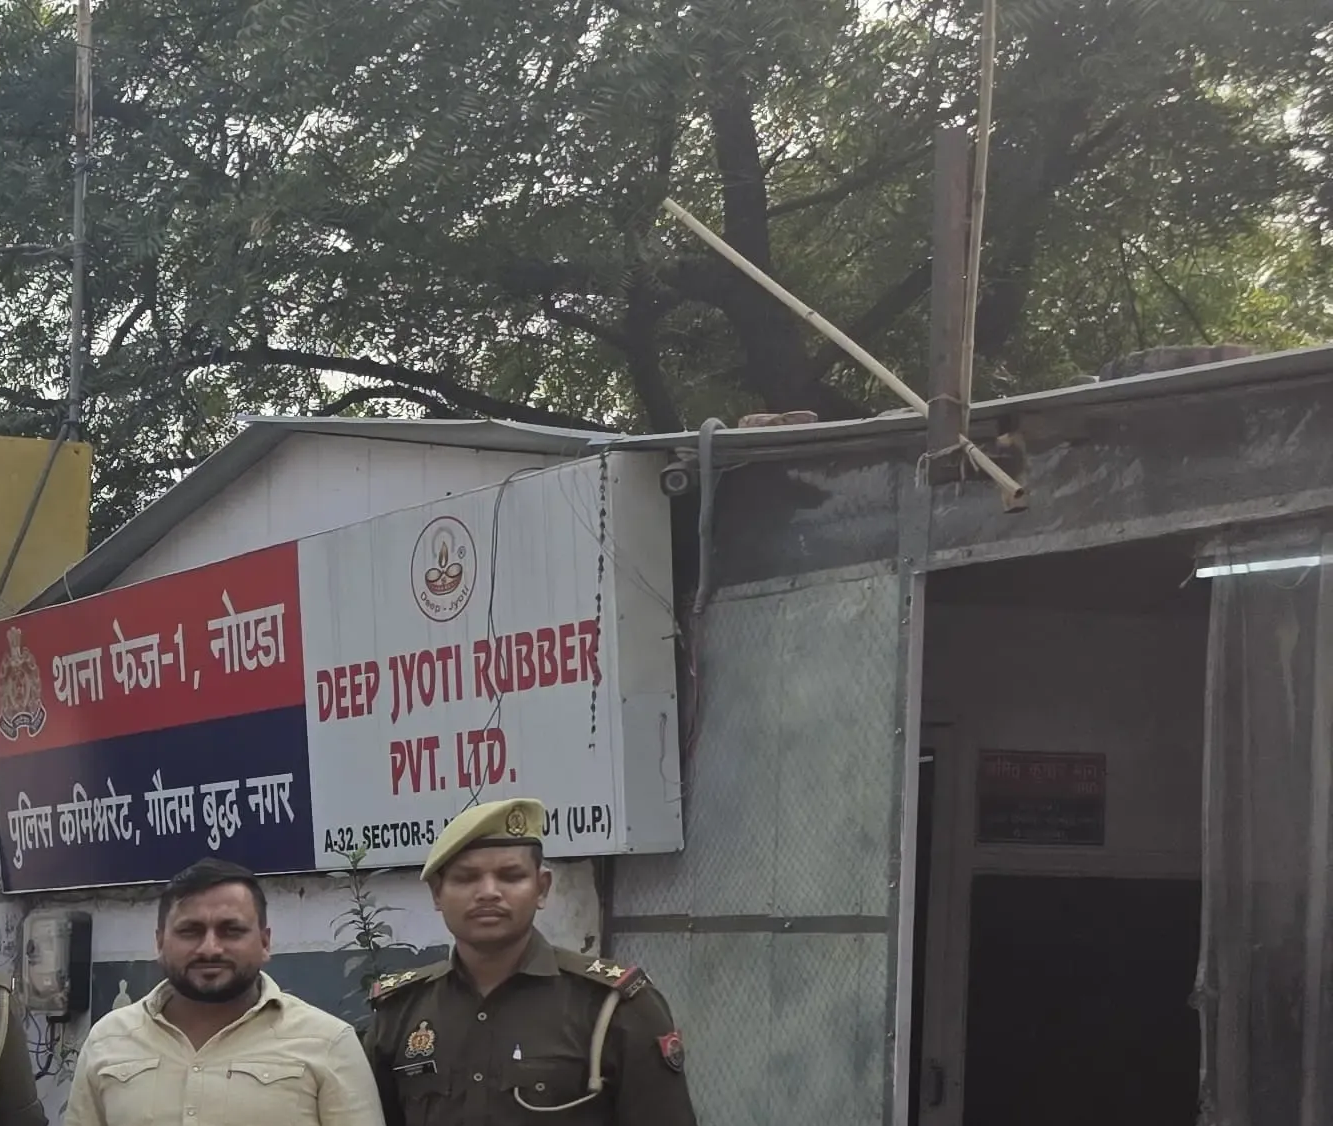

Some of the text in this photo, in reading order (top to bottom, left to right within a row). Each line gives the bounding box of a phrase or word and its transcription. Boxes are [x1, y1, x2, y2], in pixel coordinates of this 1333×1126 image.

[52, 647, 104, 707] थाना
[207, 588, 286, 674] नोएडा
[316, 618, 603, 724] DEEP JYOTI RUBBER
[389, 727, 517, 796] PVT. LTD.
[7, 791, 54, 869] पुलिस
[144, 767, 195, 836] गौतम
[199, 779, 241, 851] बुद्ध
[245, 772, 295, 824] नगर
[566, 803, 612, 842] (U.P.)
